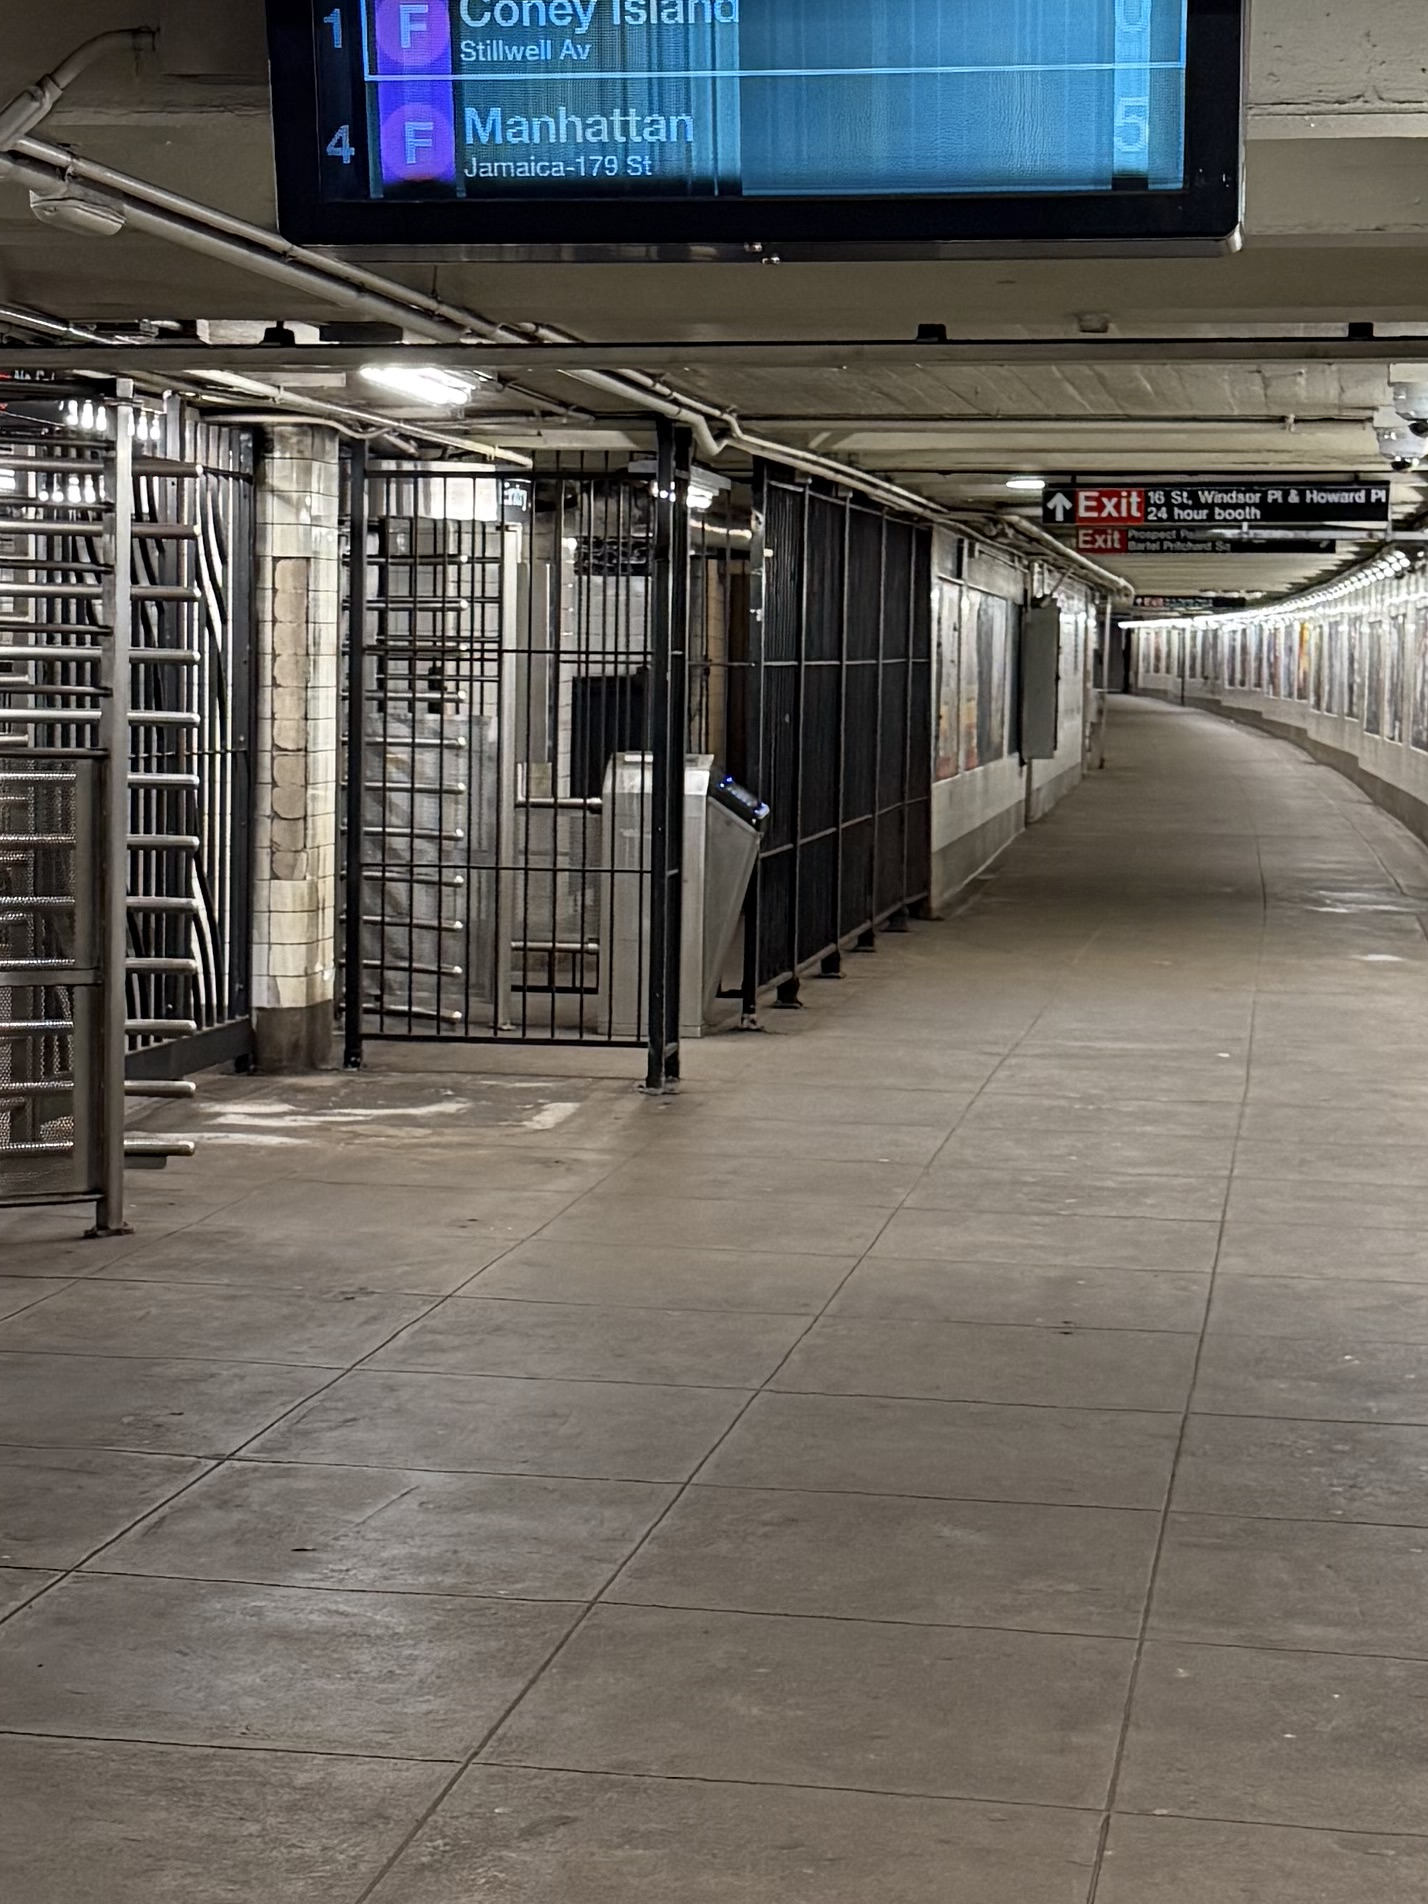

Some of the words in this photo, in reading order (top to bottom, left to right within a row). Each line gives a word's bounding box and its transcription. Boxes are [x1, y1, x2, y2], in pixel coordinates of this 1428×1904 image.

[324, 8, 342, 49] 1
[400, 4, 429, 49] F
[460, 39, 552, 62] Stillwell
[559, 38, 593, 61] Av
[464, 106, 694, 146] Manhattan
[1115, 96, 1149, 152] 5
[326, 124, 355, 165] 4
[404, 120, 434, 165] F
[464, 155, 619, 178] Jamaica-179
[626, 155, 653, 177] St
[1078, 491, 1142, 517] Exit
[1147, 507, 1168, 520] 24
[1174, 506, 1209, 520] hour
[1214, 506, 1261, 520] booth
[1148, 490, 1165, 504] 16
[1171, 490, 1193, 505] St,
[1198, 489, 1262, 504] Windsor
[1267, 489, 1283, 503] Pl
[1288, 488, 1300, 503] &
[1305, 489, 1366, 503] Howard
[1371, 489, 1386, 503] Pl
[1078, 528, 1121, 549] Exit
